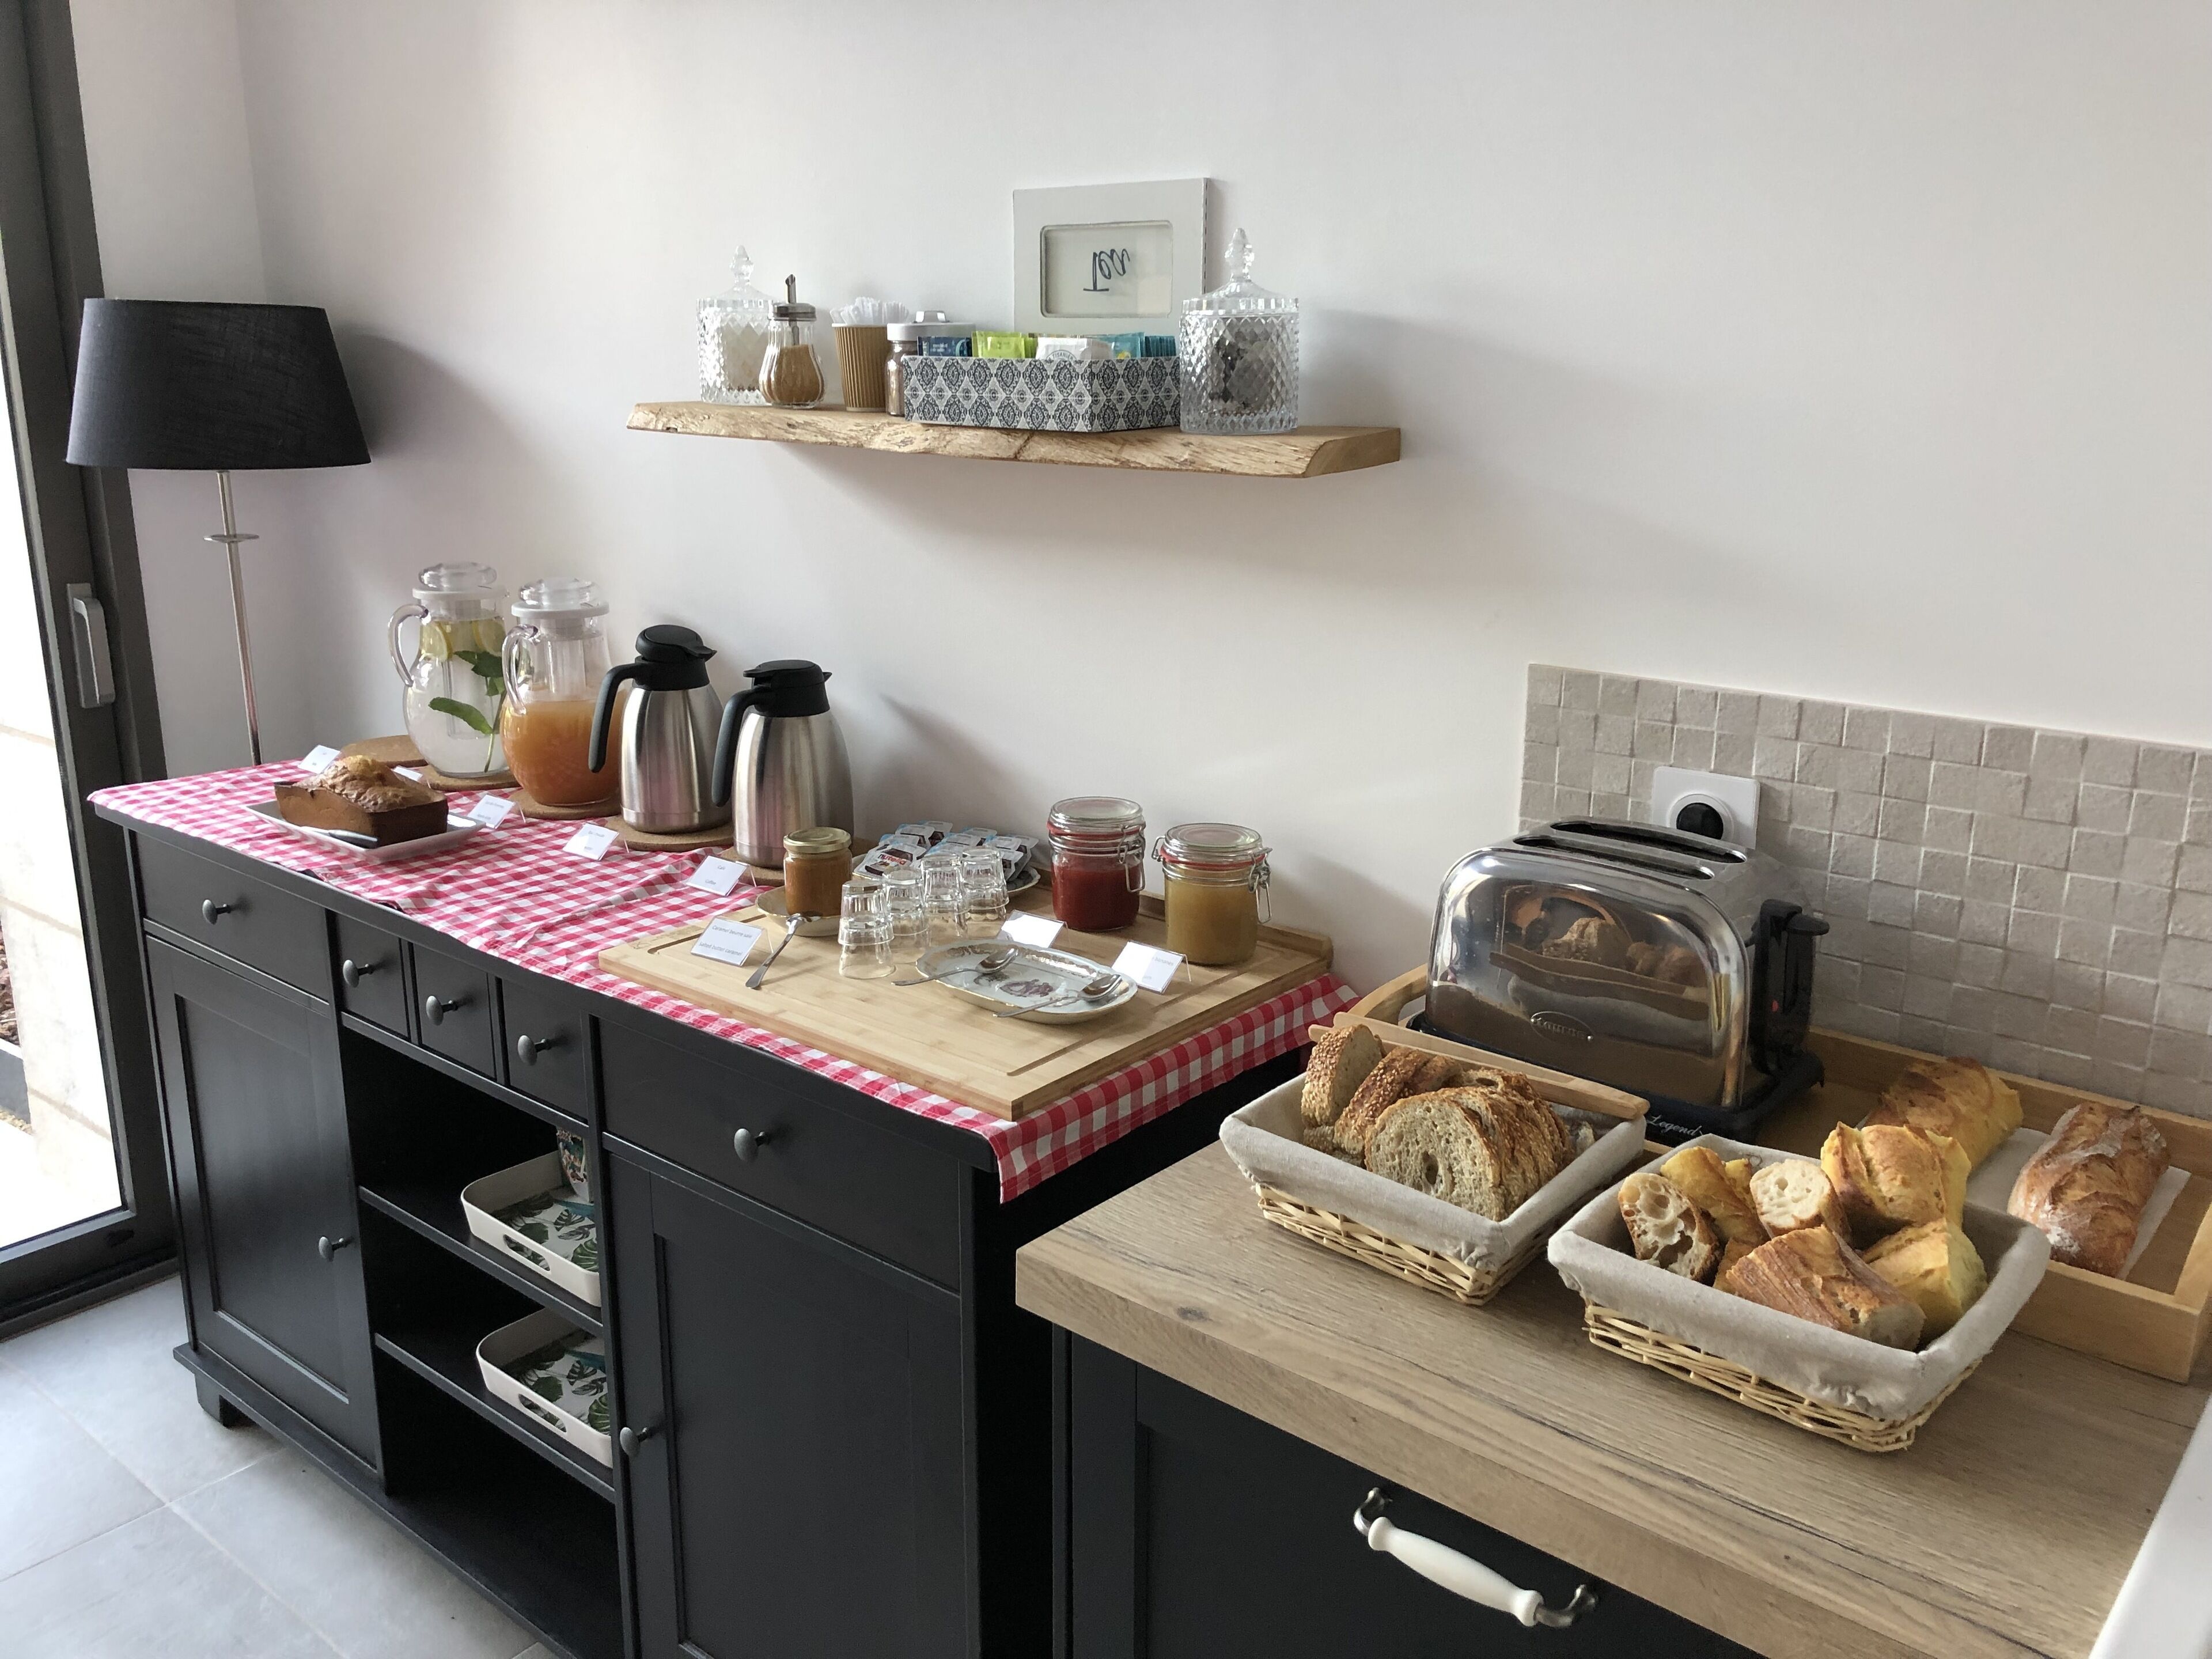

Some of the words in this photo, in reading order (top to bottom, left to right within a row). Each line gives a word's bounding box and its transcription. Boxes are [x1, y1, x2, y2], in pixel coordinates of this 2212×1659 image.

[878, 854, 906, 865] nutella
[712, 925, 730, 933] Caramel
[1646, 1114, 1702, 1136] Legend
